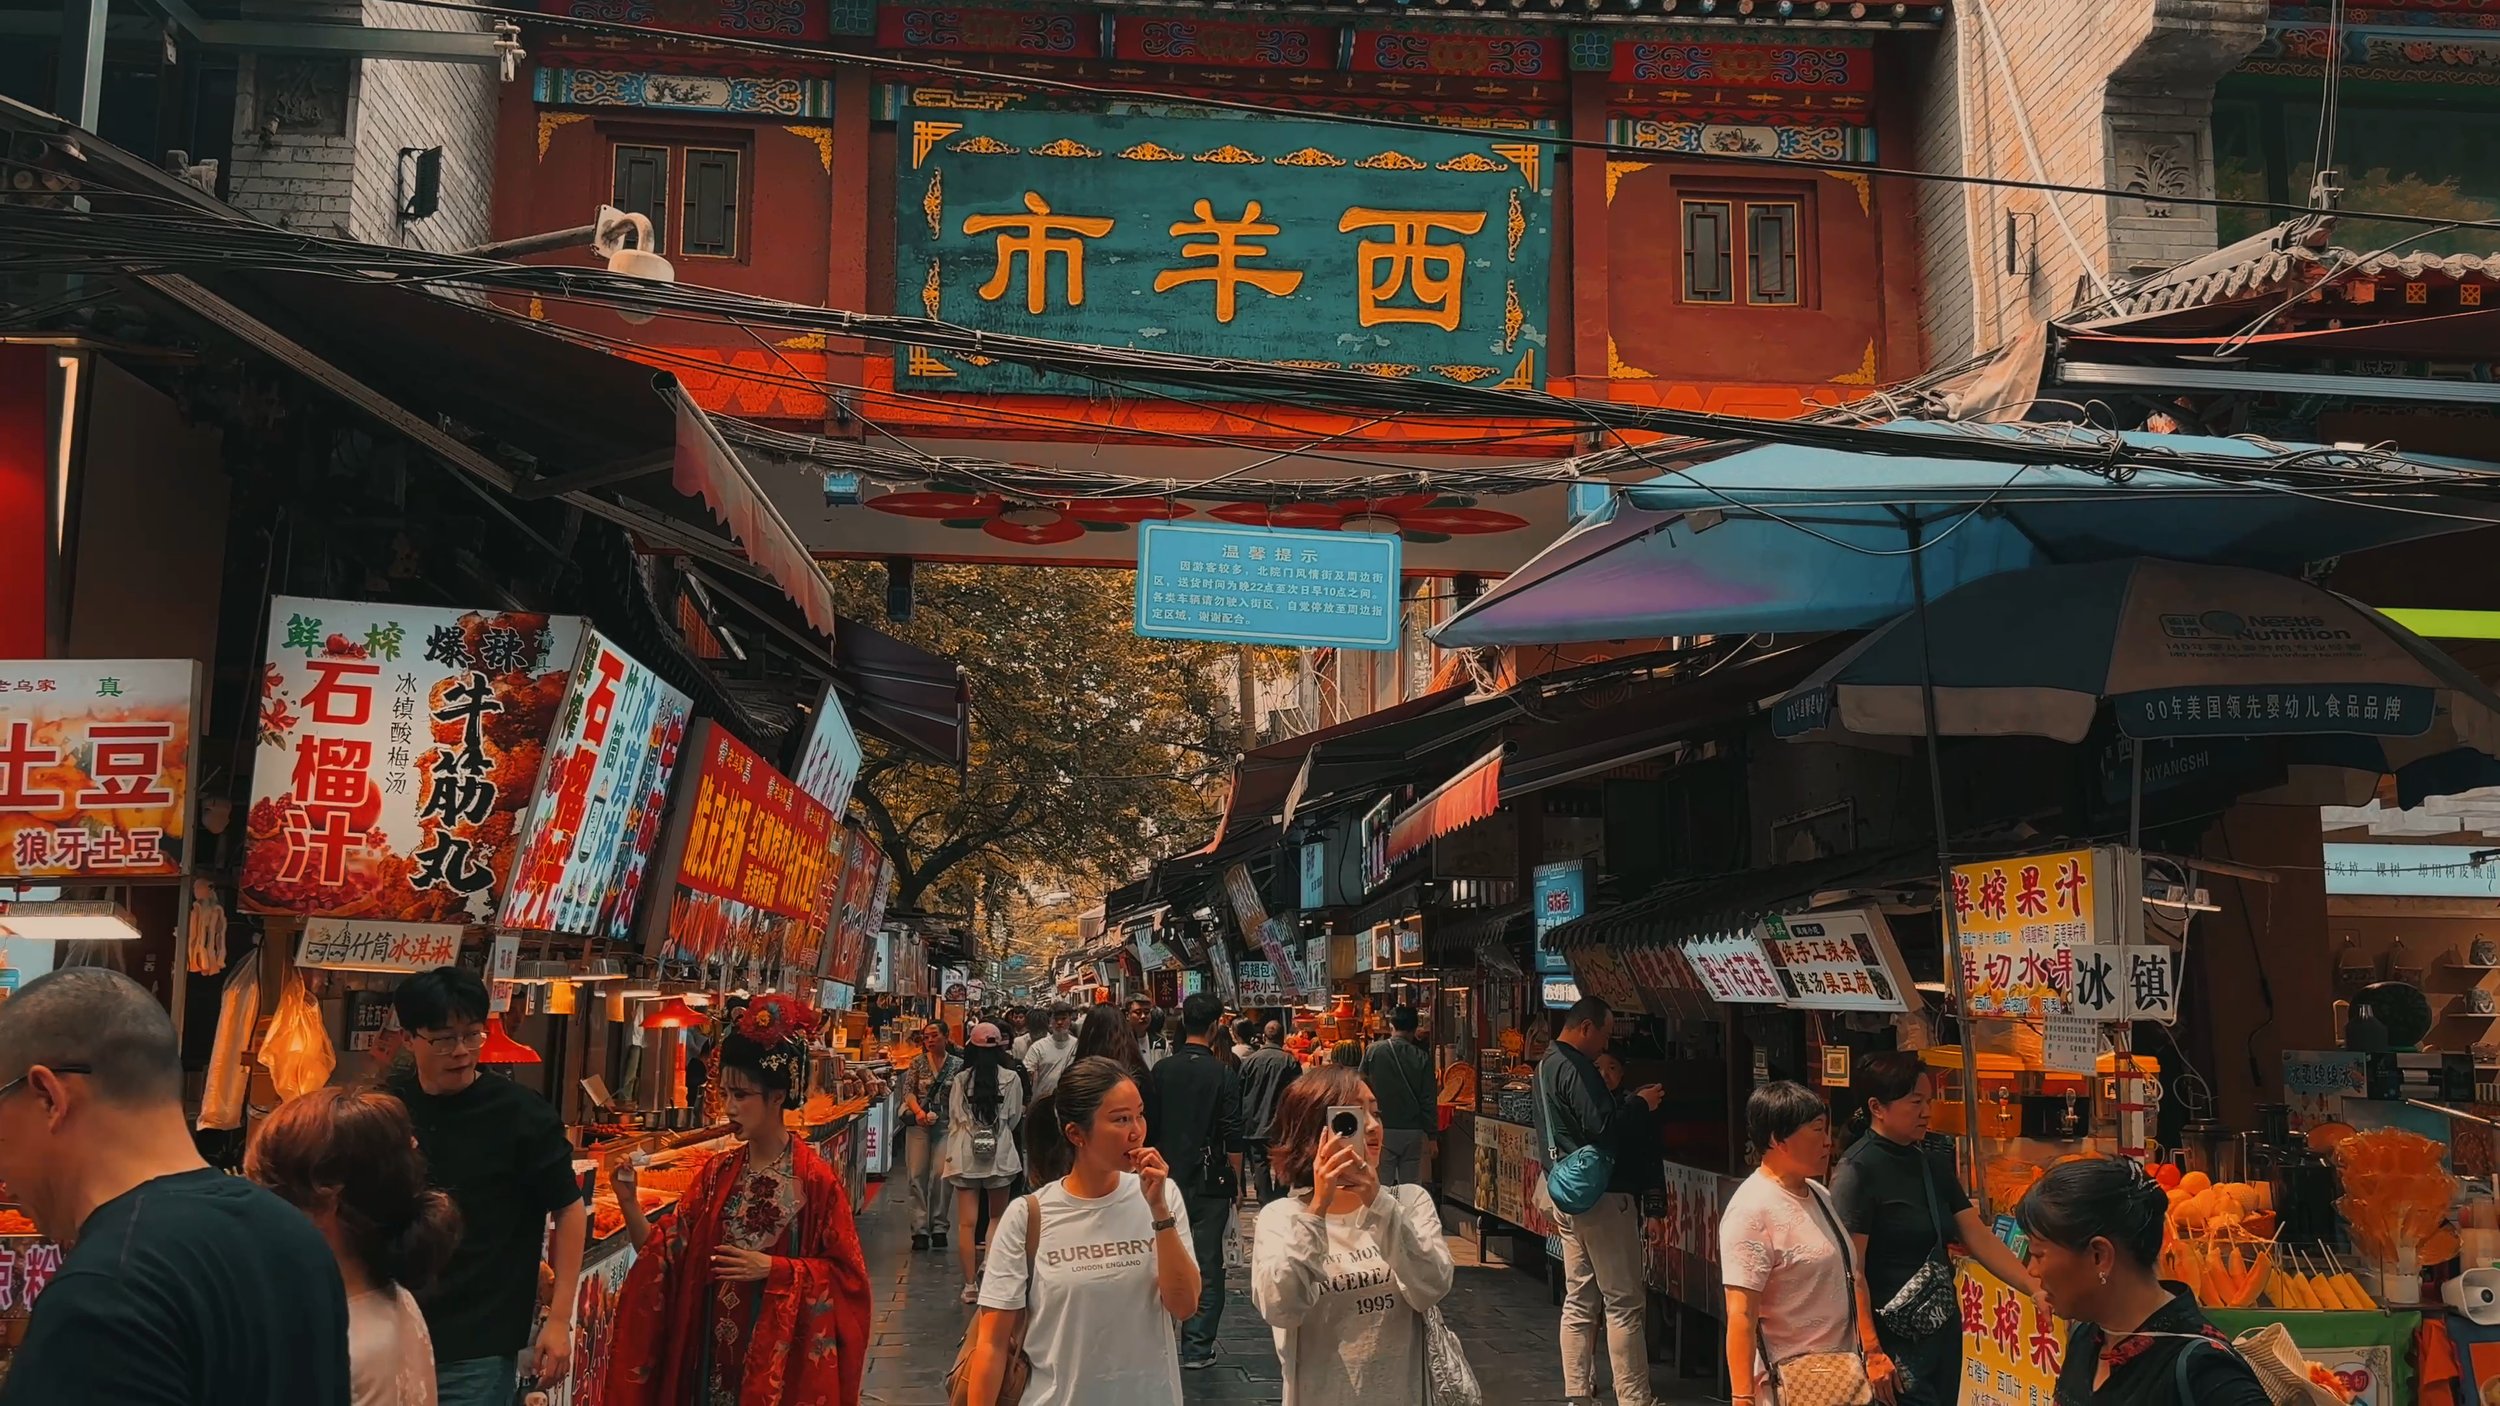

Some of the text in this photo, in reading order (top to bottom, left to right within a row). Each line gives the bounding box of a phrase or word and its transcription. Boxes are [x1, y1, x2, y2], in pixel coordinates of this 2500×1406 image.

[1222, 544, 1318, 563] 温馨提示
[282, 613, 406, 662] 鲜榨
[423, 624, 528, 674] 爆辣
[2236, 627, 2352, 640] Nutrition
[96, 677, 123, 697] 真
[2145, 693, 2402, 722] 80年美国领先婴幼儿食品品牌
[385, 672, 417, 794] 冰镇酸梅汤
[0, 719, 174, 810] 土豆
[276, 660, 381, 886] 石榴汁
[593, 674, 656, 878] 冰淇淋
[2144, 750, 2209, 783] XIYANGSHI
[407, 671, 504, 896] 牛筋丸
[15, 827, 163, 870] 狼牙土豆
[350, 931, 454, 964] 竹筒冰淇淋
[1782, 938, 1858, 964] 纯手工辣条
[1240, 963, 1275, 978] 鸡翅包
[2075, 952, 2170, 1011] 冰镇
[1047, 1236, 1155, 1266] BURBERRY
[1071, 1259, 1141, 1272] LONDON ENGLAND
[1356, 1294, 1394, 1315] 1995
